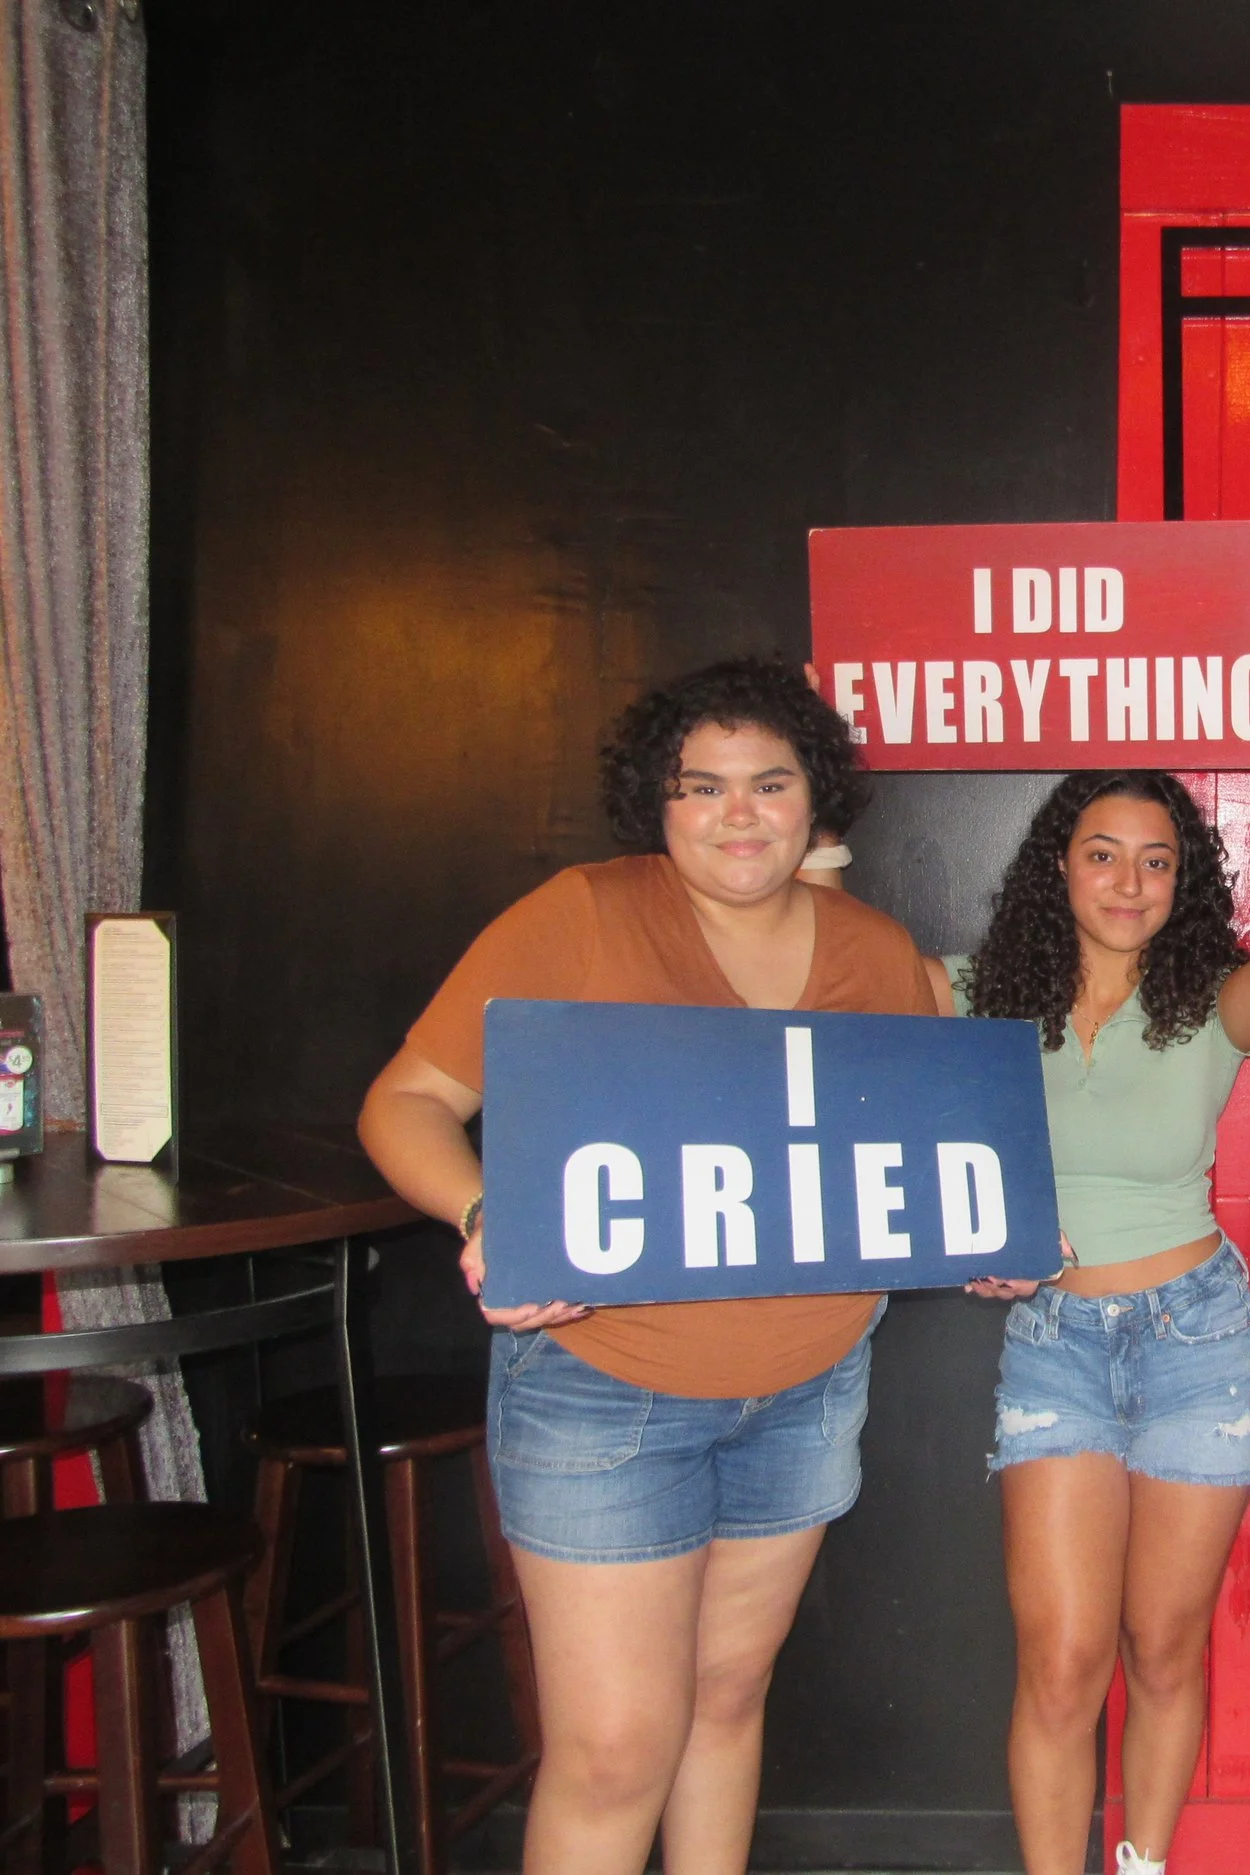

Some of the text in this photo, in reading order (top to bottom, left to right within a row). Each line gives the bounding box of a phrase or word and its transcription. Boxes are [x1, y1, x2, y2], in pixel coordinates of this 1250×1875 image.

[973, 567, 1125, 634] I DID
[785, 1026, 816, 1127] I
[563, 1142, 1008, 1275] CRIED
